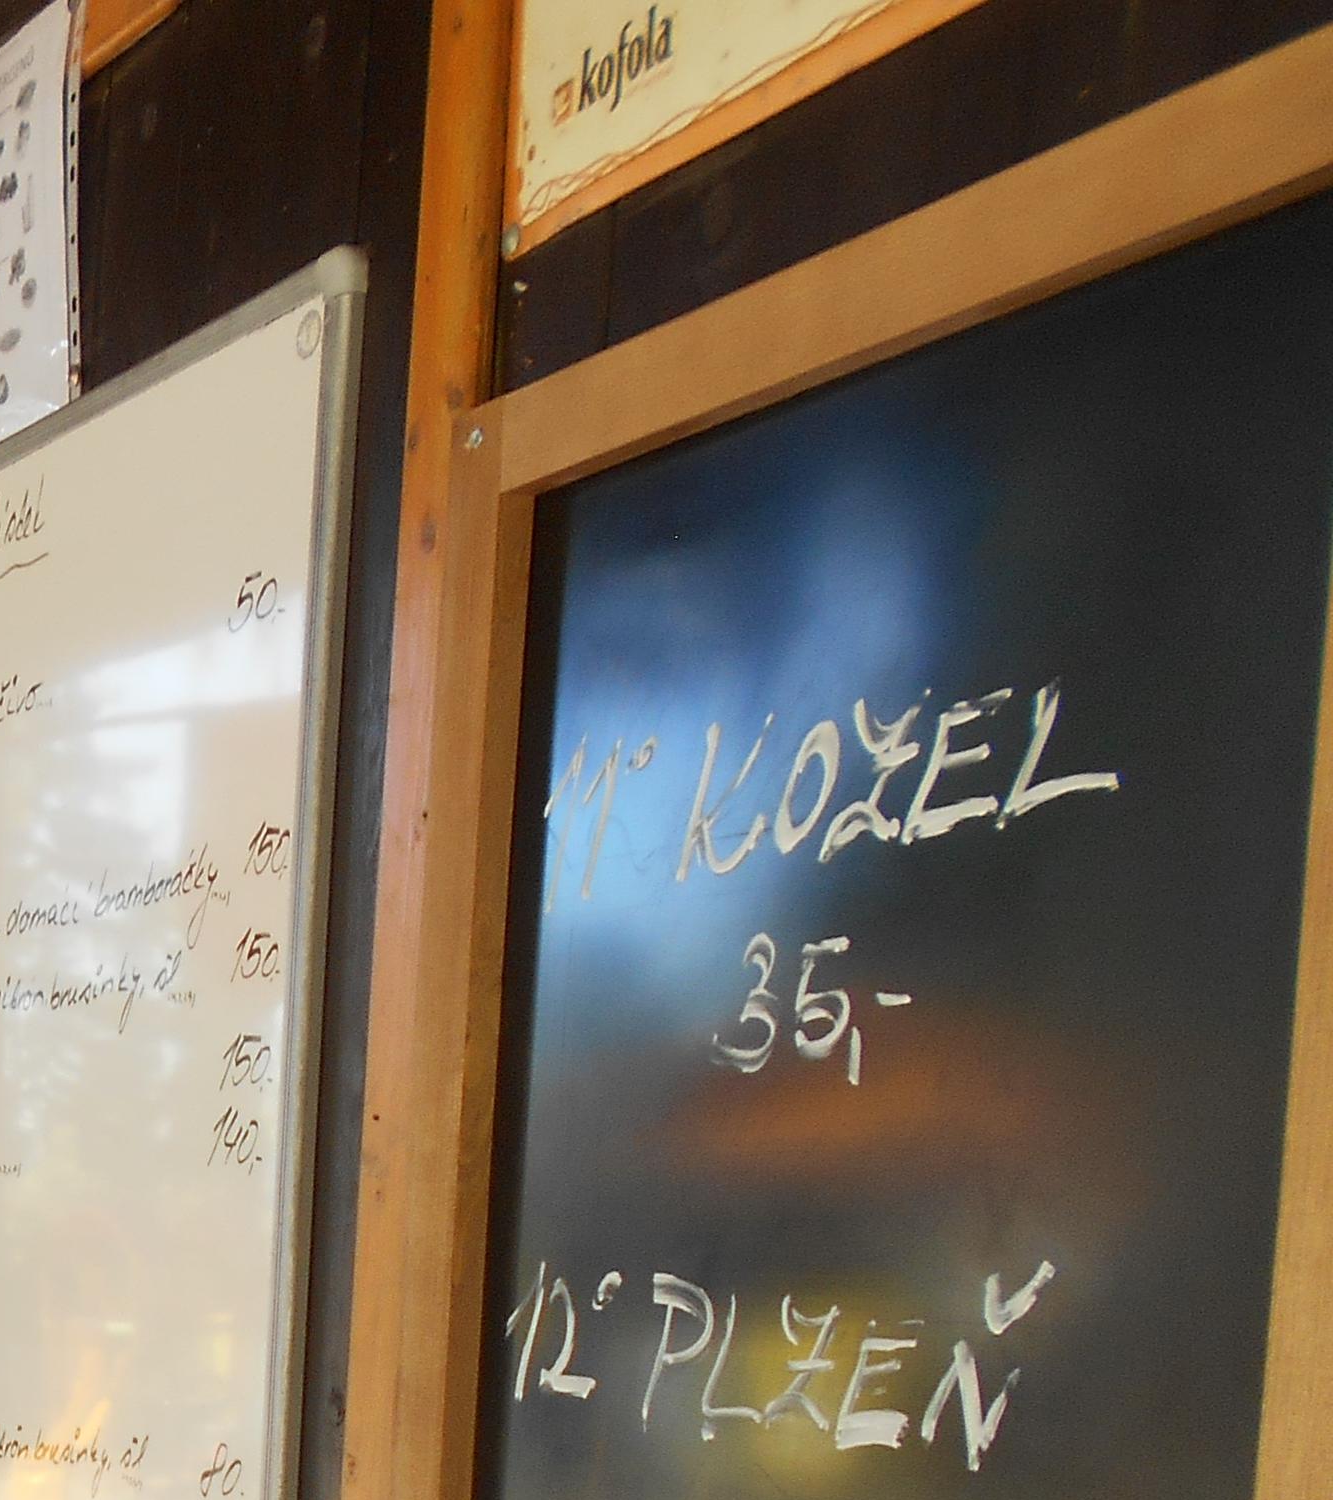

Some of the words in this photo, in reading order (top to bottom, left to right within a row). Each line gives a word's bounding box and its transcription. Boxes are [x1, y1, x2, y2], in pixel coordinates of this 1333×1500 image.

[578, 5, 674, 113] kofola
[709, 932, 913, 1087] 35,-
[641, 1260, 1056, 1473] PLZEŇ
